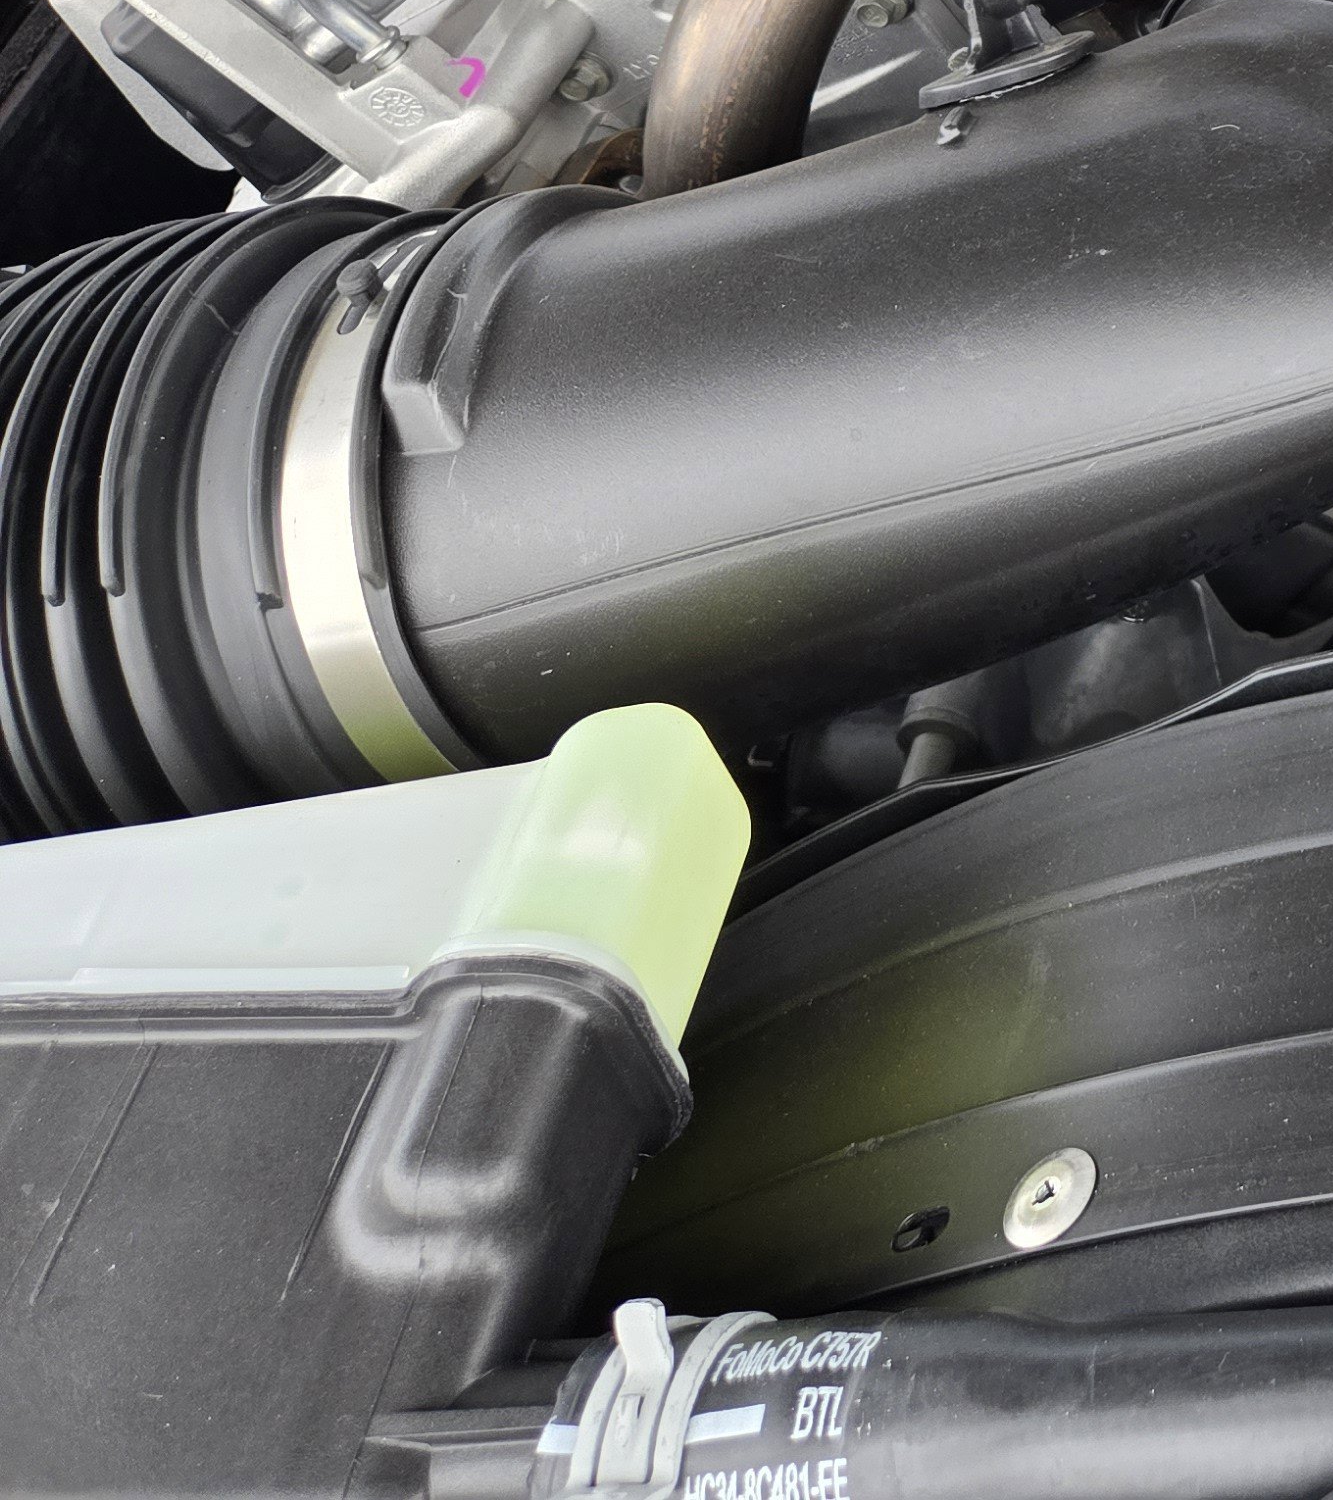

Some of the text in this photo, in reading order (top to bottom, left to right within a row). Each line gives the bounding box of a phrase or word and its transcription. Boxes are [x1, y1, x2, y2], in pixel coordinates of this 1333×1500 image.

[711, 1331, 882, 1385] FoMoCo C757R
[791, 1386, 845, 1439] BTL
